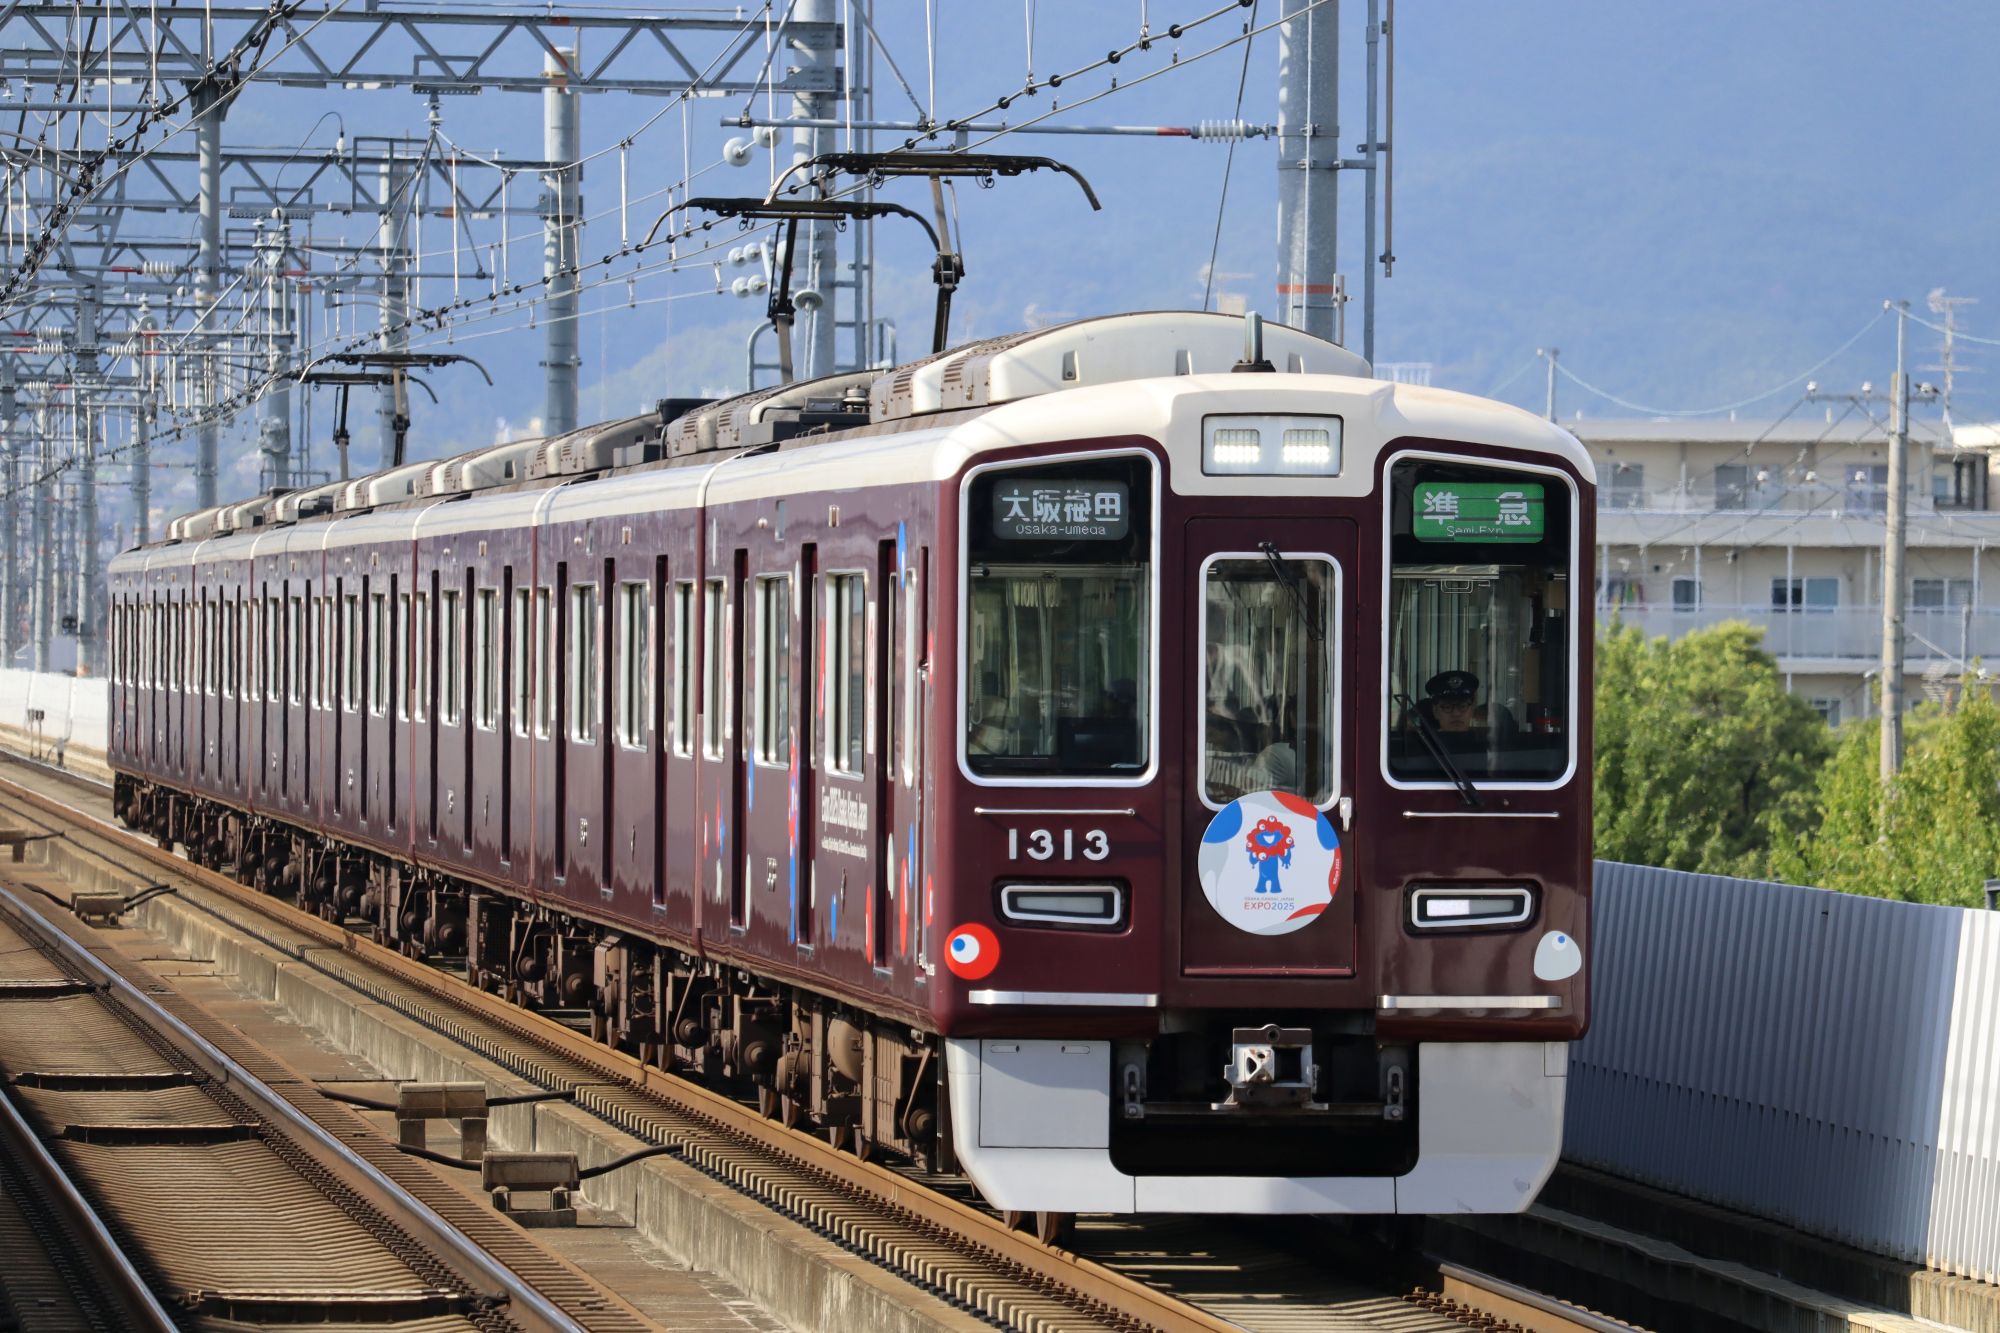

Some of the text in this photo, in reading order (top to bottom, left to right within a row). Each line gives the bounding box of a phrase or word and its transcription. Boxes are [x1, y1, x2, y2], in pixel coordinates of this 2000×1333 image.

[1001, 488, 1121, 523] 大阪梅田
[1008, 828, 1110, 861] 1313
[1244, 901, 1295, 911] EXPO2025
